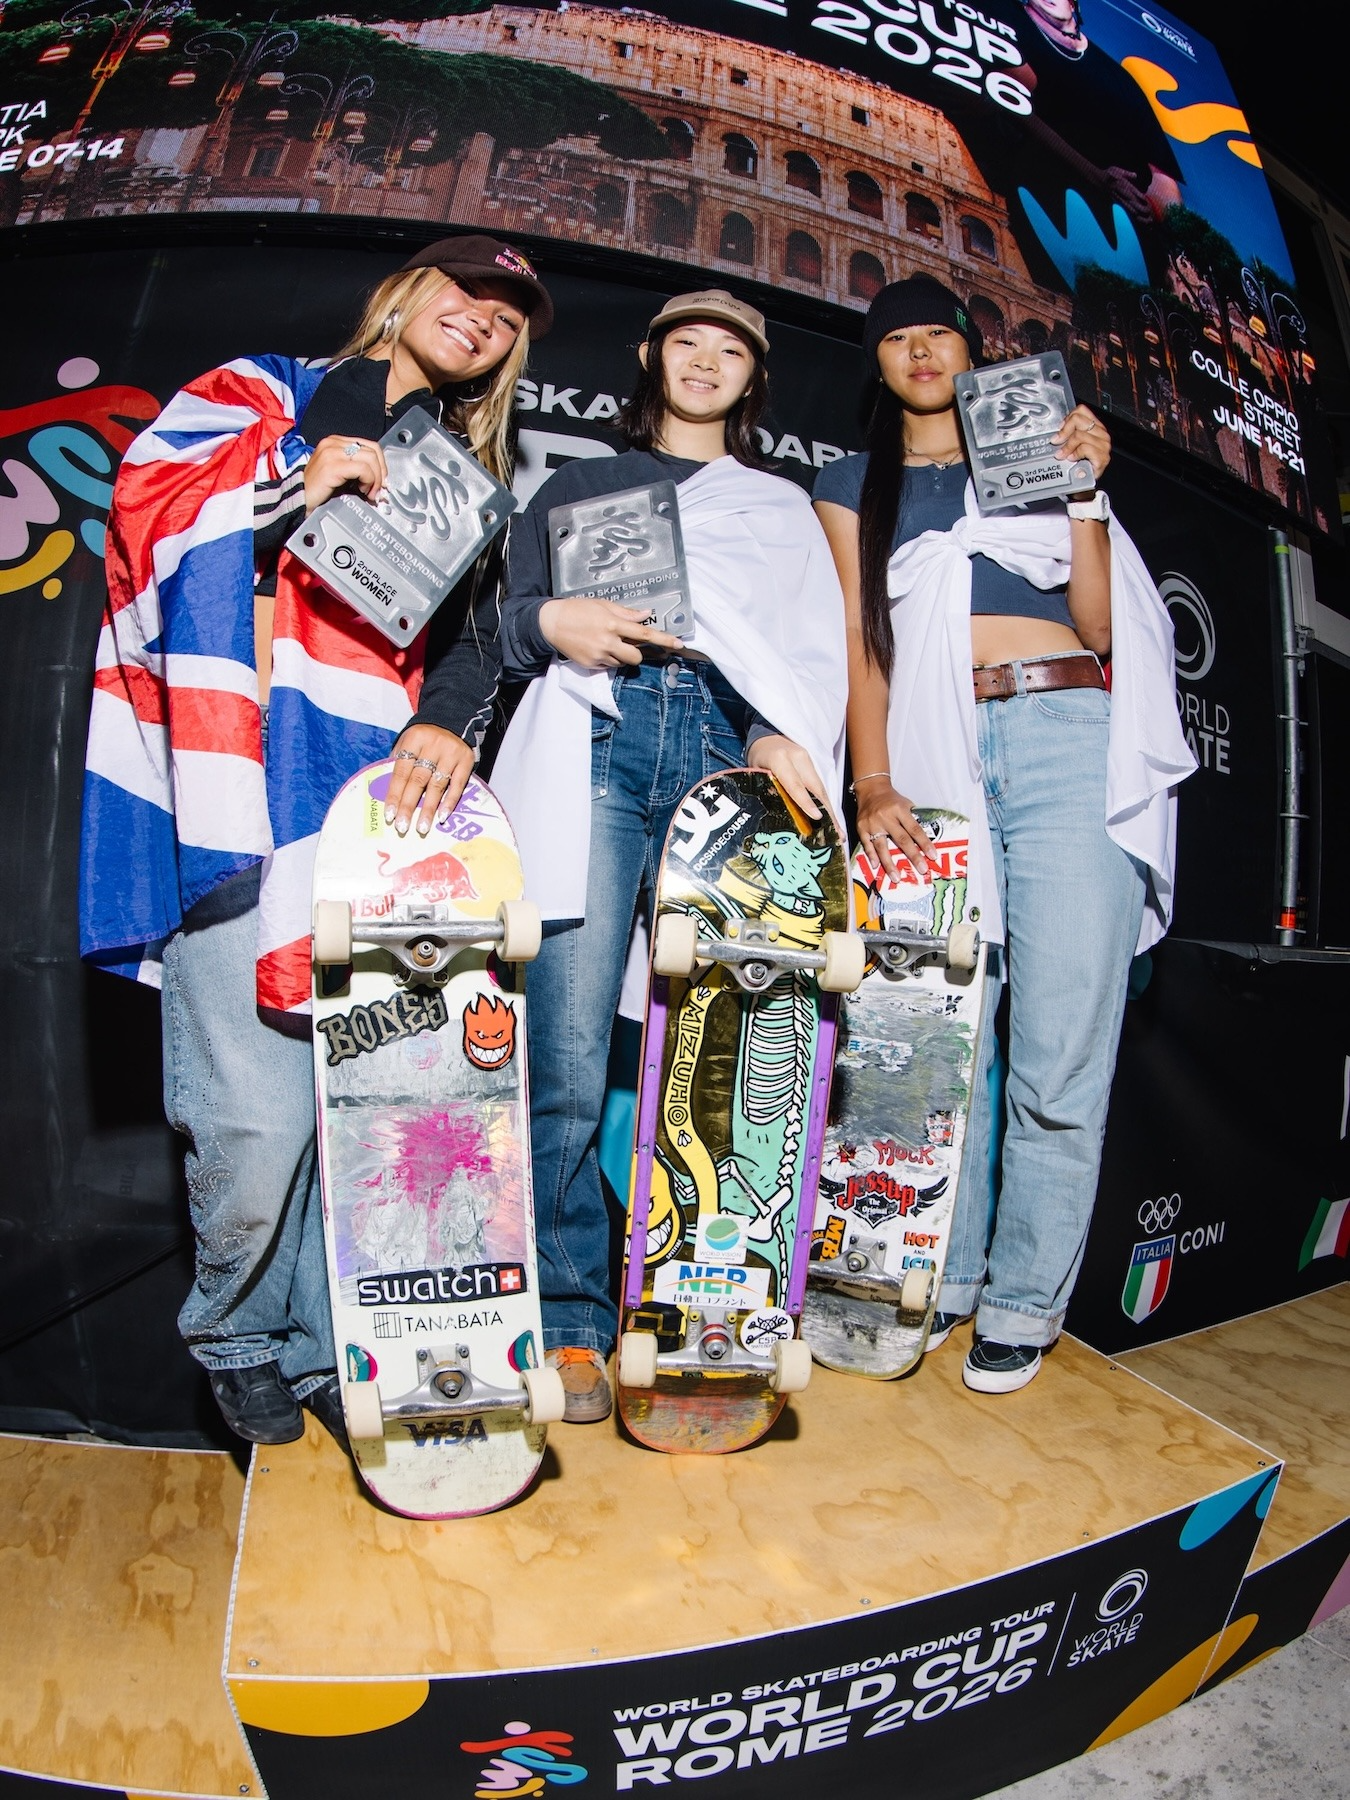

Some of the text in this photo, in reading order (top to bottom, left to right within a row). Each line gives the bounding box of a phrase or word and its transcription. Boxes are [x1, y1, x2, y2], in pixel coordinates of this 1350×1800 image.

[943, 0, 1018, 42] OUR
[811, 0, 1033, 116] 2026
[27, 138, 126, 168] 07-14
[516, 378, 628, 421] SKA
[1192, 350, 1299, 431] COLLE OPPIO
[1213, 406, 1306, 475] JUNE 14-21
[1243, 400, 1301, 452] STREET
[976, 438, 1051, 460] WORLD SKATEBOA
[1005, 451, 1028, 462] TOUR
[1024, 464, 1062, 477] 3rd PLACE
[1025, 471, 1064, 486] WOMEN
[340, 494, 444, 590] WORLD SKATEBOARDING
[360, 523, 387, 552] TOUR
[350, 568, 393, 608] WOMEN
[357, 560, 398, 598] 2nd PLACE
[597, 572, 680, 597] SKATEBOARDING
[369, 797, 378, 832] NABATA
[435, 813, 484, 842] SB
[693, 811, 752, 873] DCSHOECOUSA
[318, 992, 448, 1065] BONES
[667, 1001, 705, 1127] MIZUHO
[903, 1231, 940, 1249] HOT
[1136, 1241, 1171, 1261] ITALIA
[1180, 1221, 1226, 1254] CONI
[358, 1267, 498, 1304] swatch
[678, 1264, 747, 1296] NEP
[404, 1310, 504, 1332] TANABATA
[401, 1418, 489, 1448] VISA
[1066, 1624, 1140, 1668] SKATE
[1073, 1612, 1144, 1652] WORLD
[613, 1601, 1056, 1722] WORLD SKATEBOARDING TOUR
[613, 1621, 1048, 1758] WORLD CUP
[616, 1656, 1038, 1791] ROME 2026
